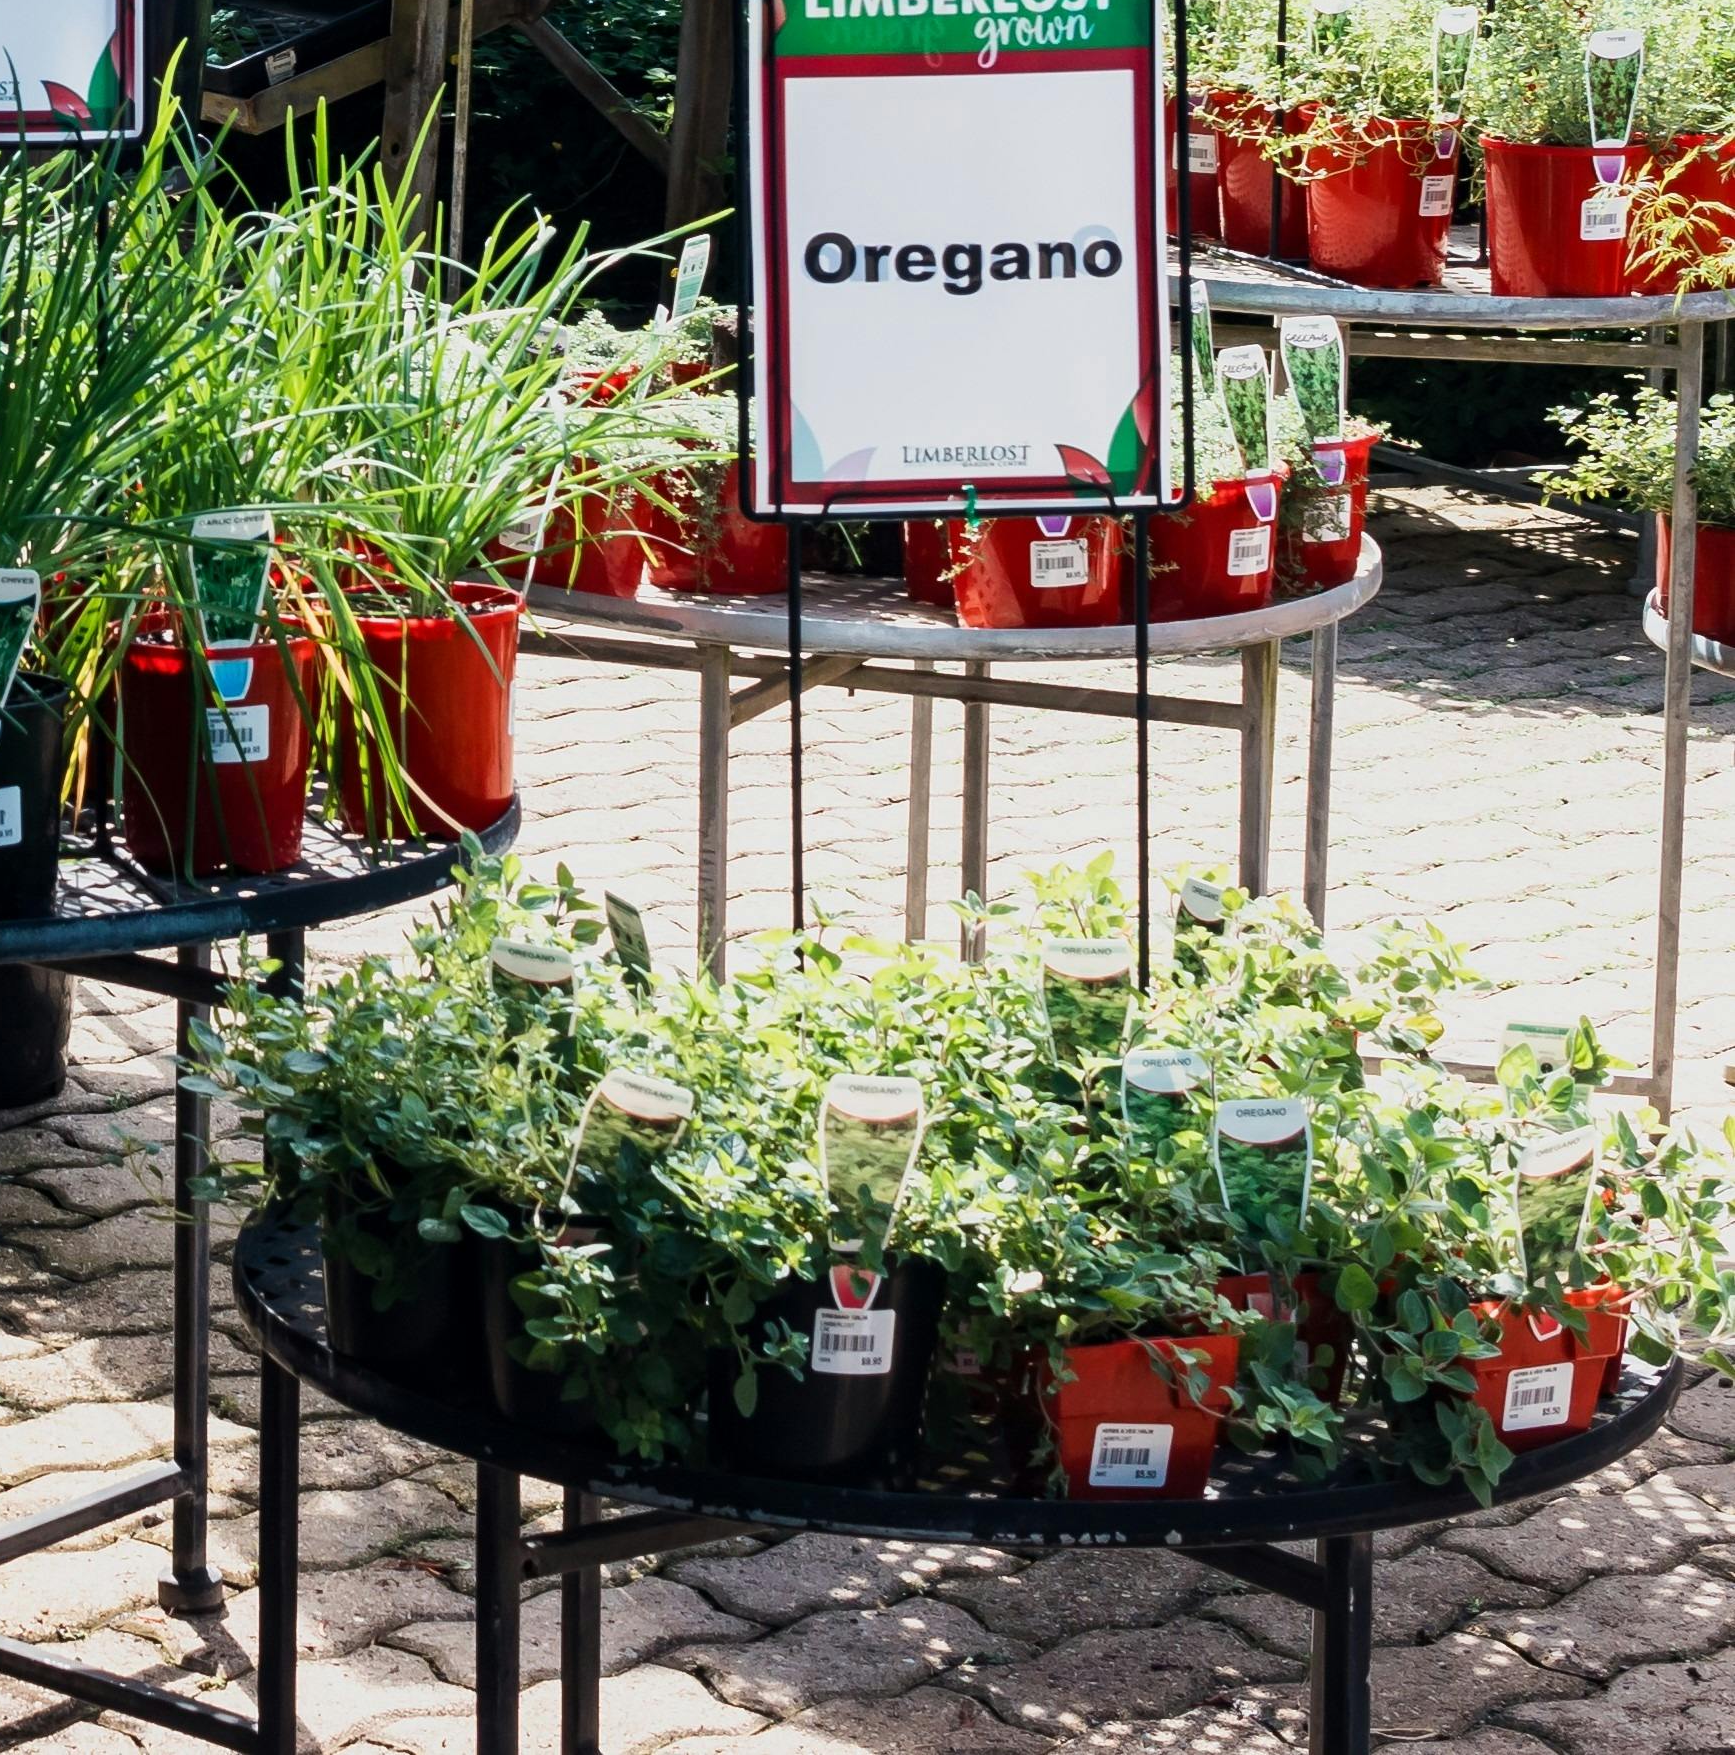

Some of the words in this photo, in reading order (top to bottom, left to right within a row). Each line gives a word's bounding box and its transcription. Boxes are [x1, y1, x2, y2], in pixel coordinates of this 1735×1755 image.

[973, 15, 1095, 69] grown
[803, 231, 1124, 296] Oregano
[902, 444, 1032, 464] LIMBERLOST
[508, 947, 555, 962] OREGANO
[1061, 946, 1112, 955] OREGANO
[1141, 1056, 1191, 1067] OREGANO
[623, 1080, 675, 1102] OREGANO
[849, 1085, 901, 1095] OREGANO
[1236, 1106, 1287, 1117] OREGANO
